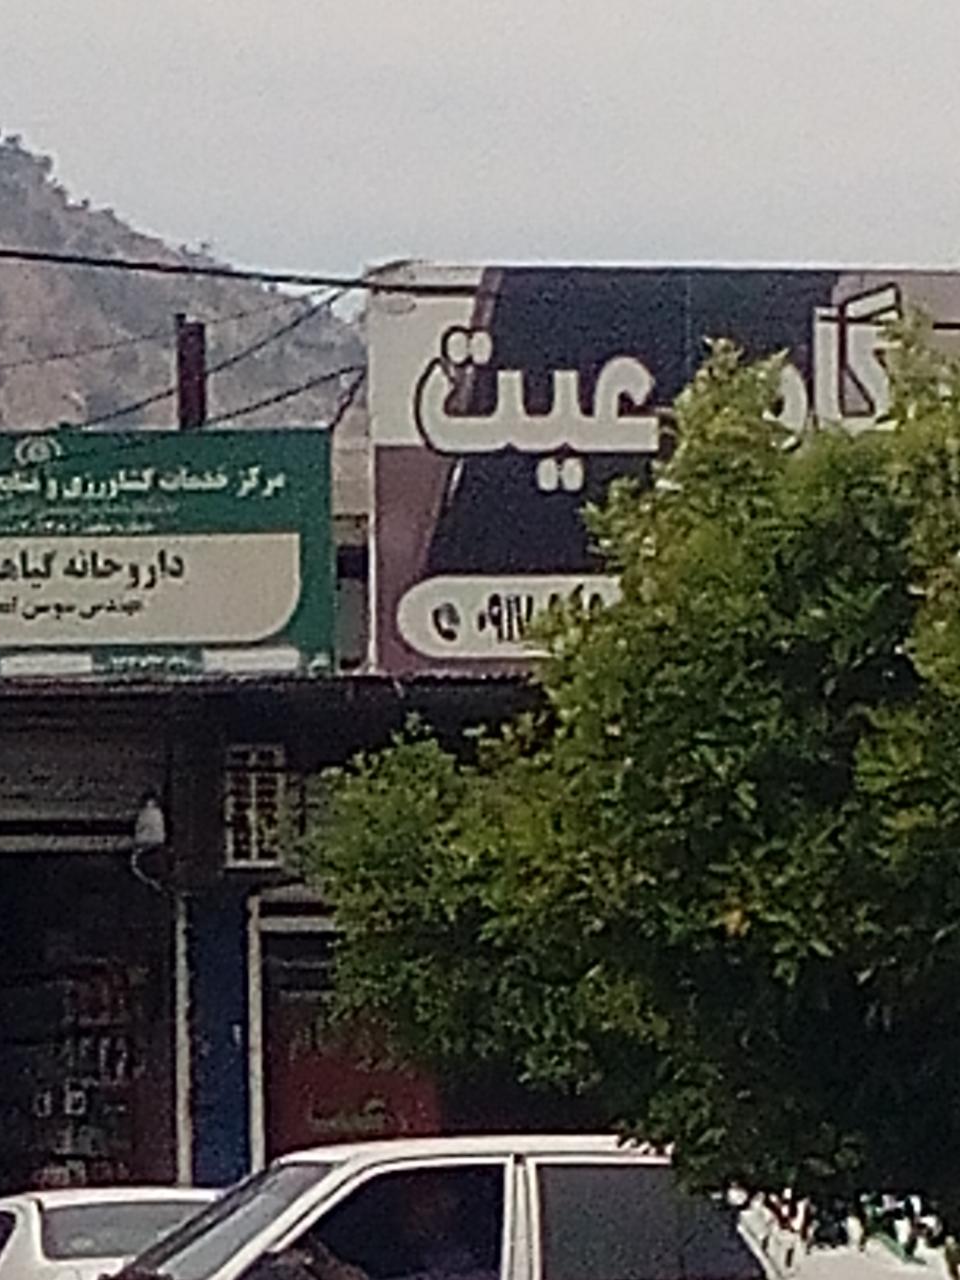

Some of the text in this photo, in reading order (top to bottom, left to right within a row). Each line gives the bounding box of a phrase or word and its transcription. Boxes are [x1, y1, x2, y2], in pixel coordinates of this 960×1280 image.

[61, 466, 156, 500] کشاورزی
[157, 463, 229, 492] خدمات
[236, 464, 286, 499] مرکز
[62, 549, 184, 590] داروخانه
